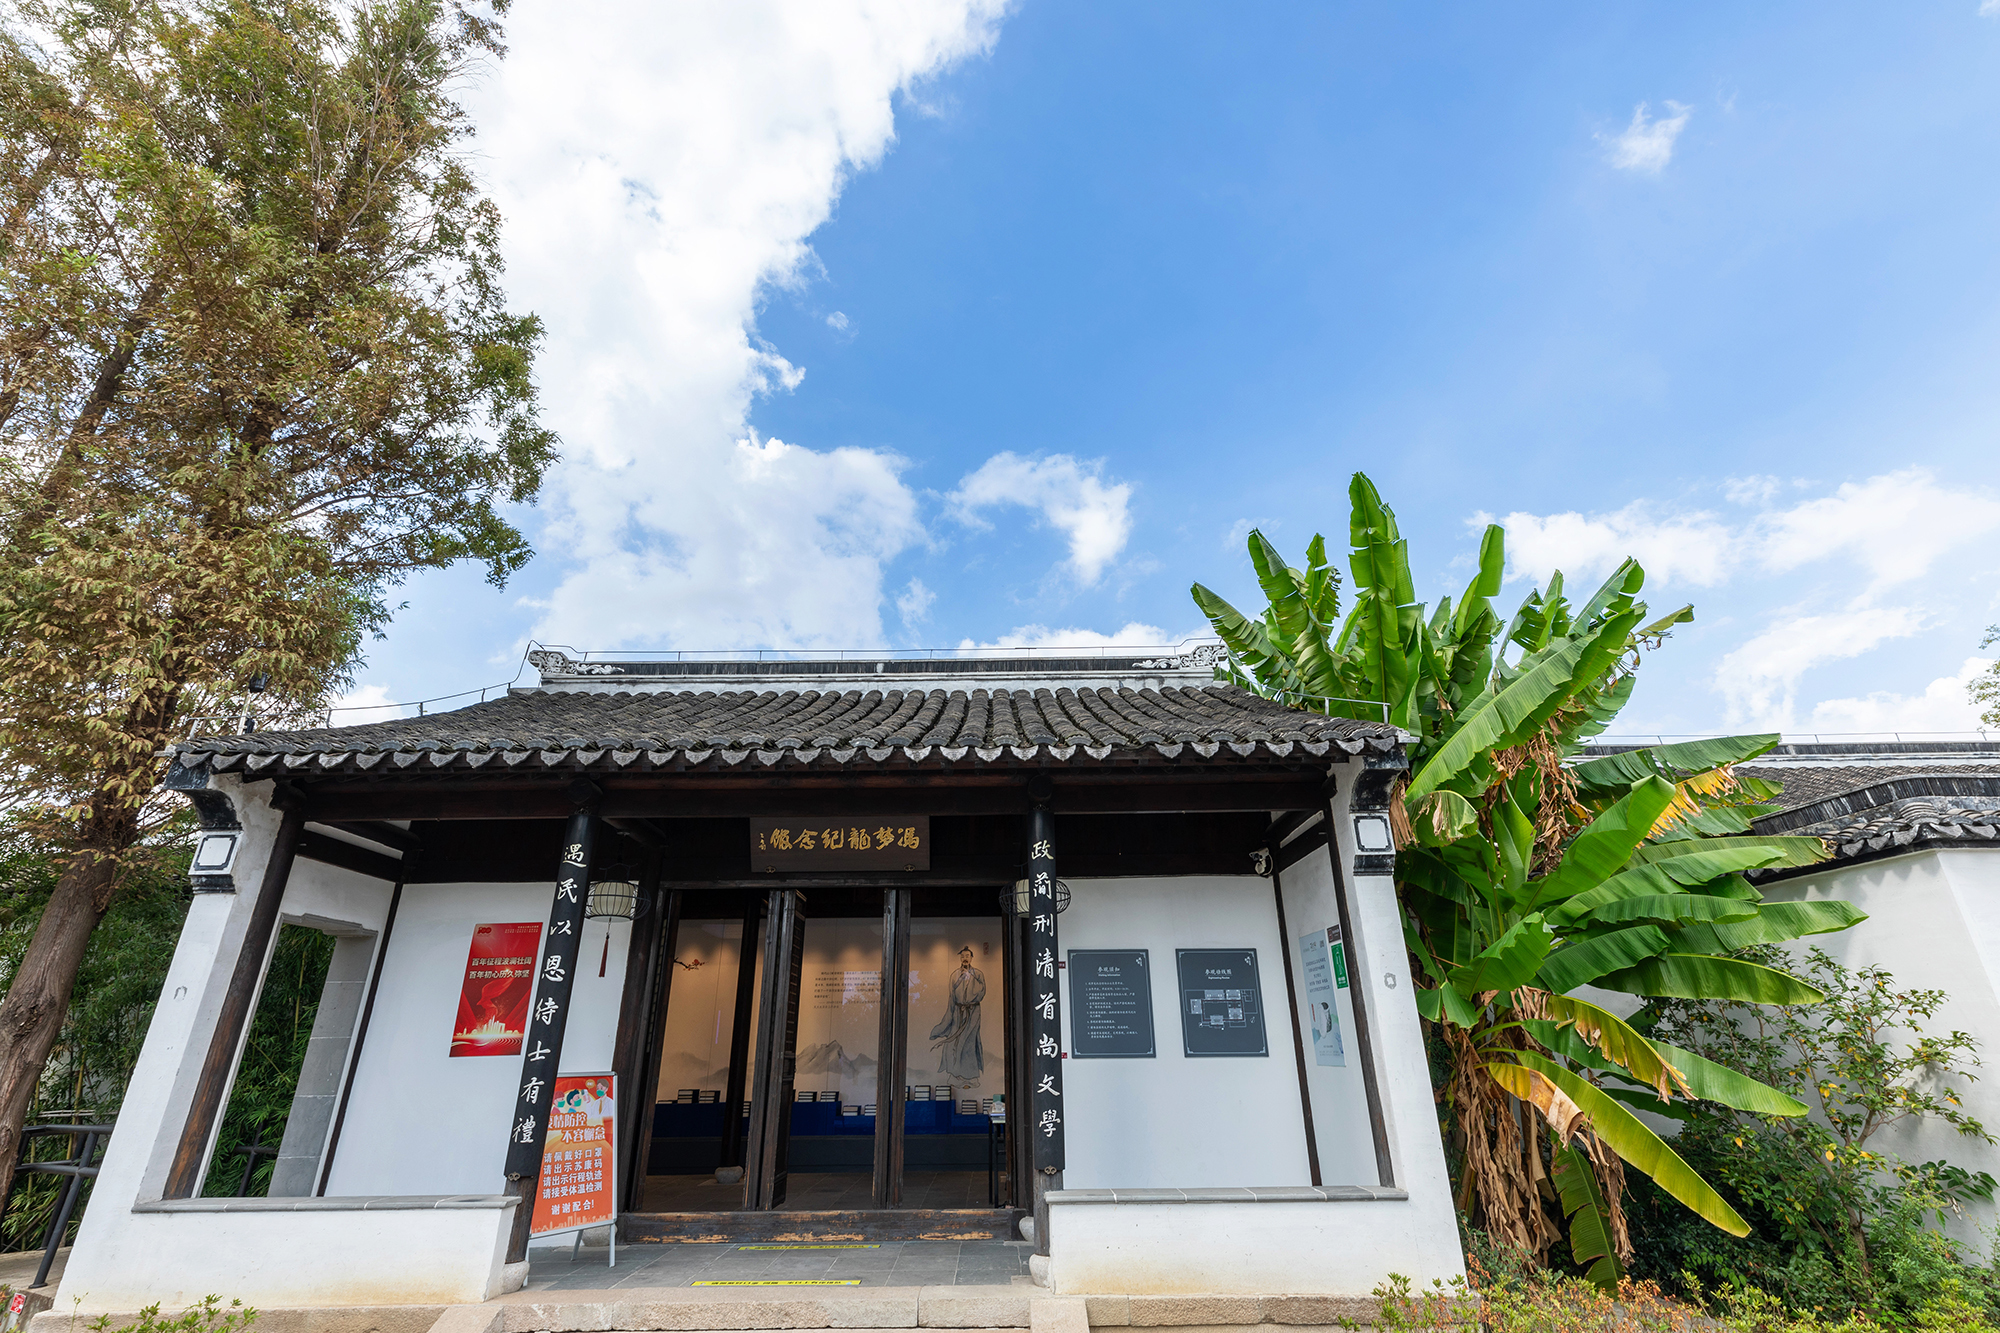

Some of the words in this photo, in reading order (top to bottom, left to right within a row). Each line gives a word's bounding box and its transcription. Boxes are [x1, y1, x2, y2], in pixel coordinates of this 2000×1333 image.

[471, 956, 533, 967] 百年征程波澜壮阔
[468, 969, 530, 980] 百年初心历久弥坚
[561, 1126, 606, 1144] 不容懈怠
[544, 1147, 603, 1163] 请佩戴好口罩
[543, 1158, 603, 1175] 请出示苏康码
[542, 1169, 603, 1187] 请出示行程轨迹
[542, 1180, 603, 1199] 请接受体温检测
